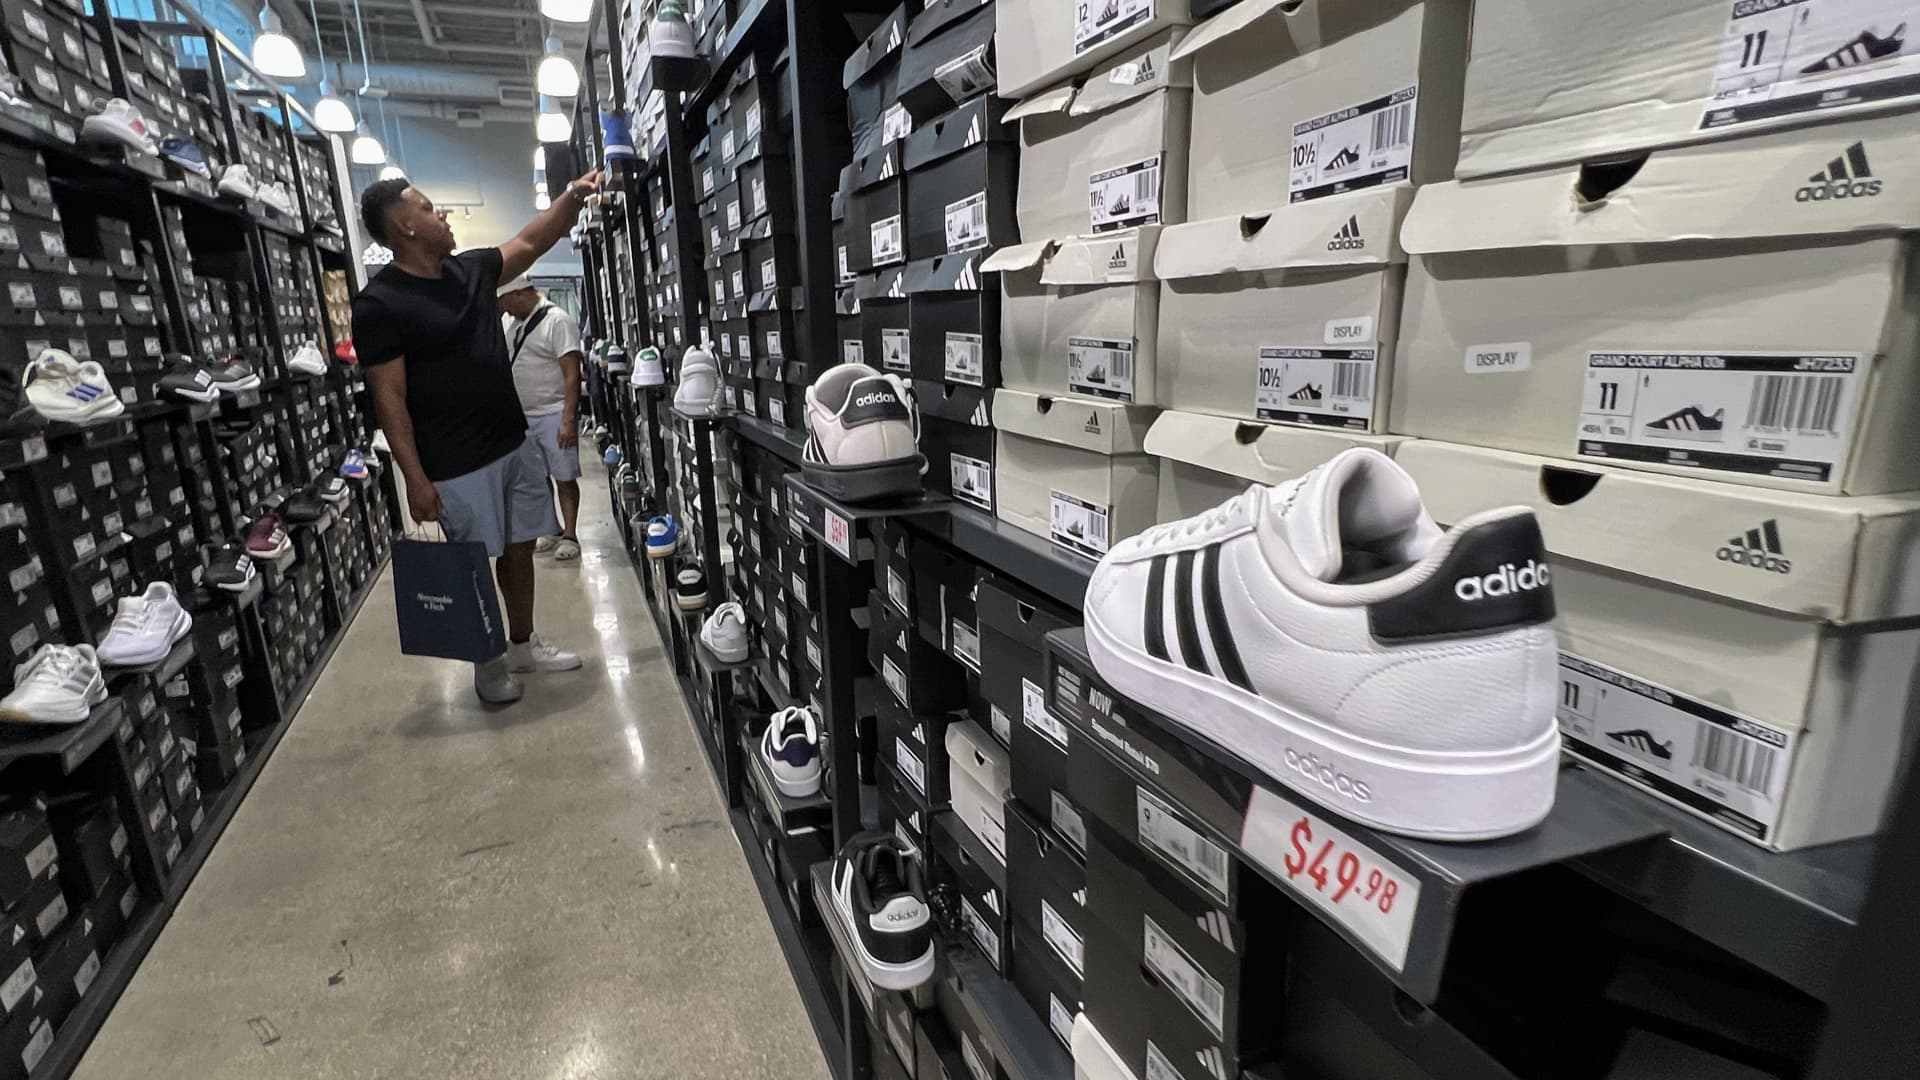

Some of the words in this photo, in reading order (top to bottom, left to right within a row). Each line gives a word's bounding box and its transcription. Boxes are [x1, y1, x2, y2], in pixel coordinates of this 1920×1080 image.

[1079, 3, 1088, 23] 12
[1741, 30, 1767, 68] 11
[1795, 180, 1882, 202] adidas
[1328, 239, 1364, 251] adidas
[1333, 326, 1362, 338] DISPLAY
[1476, 352, 1518, 367] DISPLAY
[1600, 383, 1618, 409] 11
[1716, 546, 1792, 574] adidas
[1089, 687, 1112, 717] NOW
[1564, 681, 1579, 709] 11
[1284, 748, 1374, 804] adidas
[1284, 816, 1399, 915] $49.98
